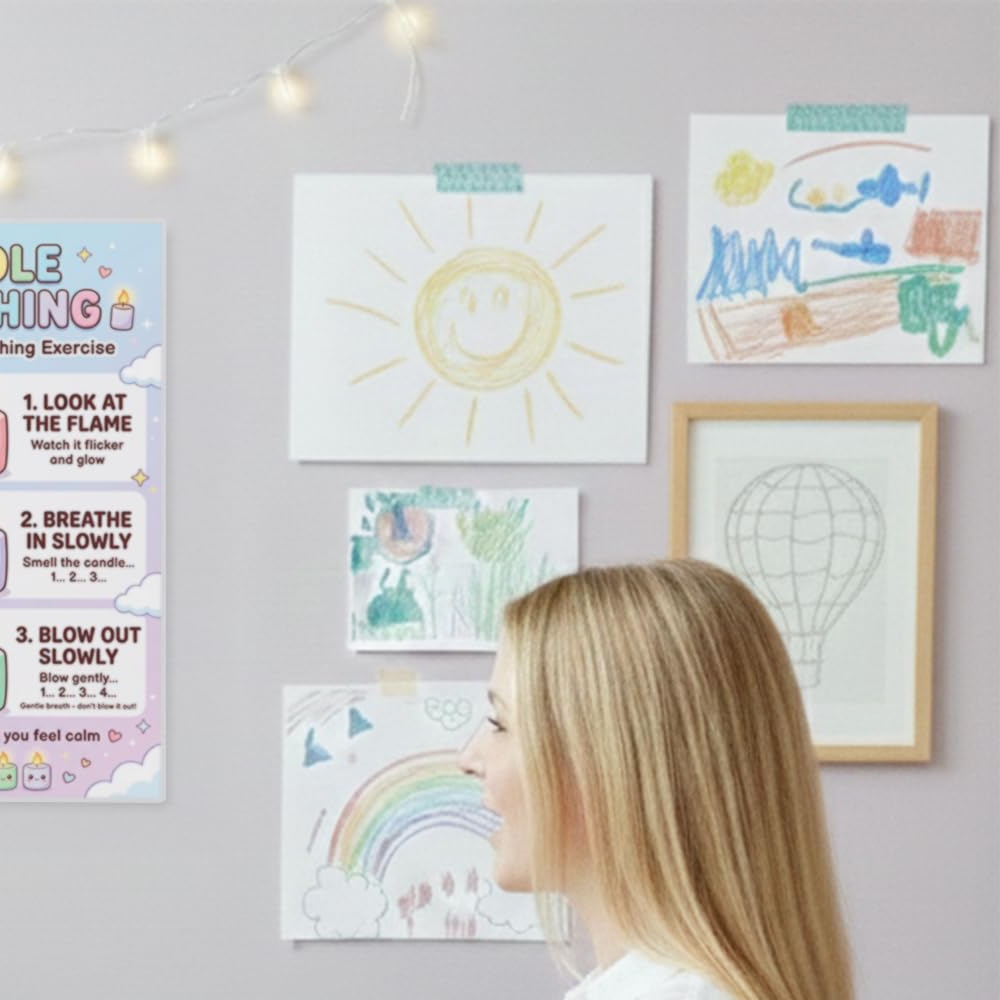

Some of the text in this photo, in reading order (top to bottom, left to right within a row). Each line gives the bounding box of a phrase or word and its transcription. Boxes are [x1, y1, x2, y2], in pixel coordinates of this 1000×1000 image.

[42, 340, 115, 354] Exercise
[24, 394, 127, 410] 1. LOOK AT
[23, 415, 132, 432] THE FLAME
[31, 440, 123, 450] Watch it flicker
[50, 454, 104, 467] and glow
[21, 511, 132, 528] 2. BREATHE
[27, 533, 131, 549] IN SLOWLY
[23, 556, 135, 568] Smell the candle...
[16, 626, 142, 643] 3. BLOW OUT
[39, 648, 118, 664] SLOWLY
[40, 672, 118, 685] Blow gently...
[20, 702, 44, 710] Gentle
[46, 702, 70, 710] breath
[77, 702, 95, 710] don't
[97, 702, 114, 710] blow
[116, 702, 121, 710] it
[122, 702, 137, 710] out!
[4, 732, 29, 744] you
[34, 729, 60, 741] feel
[65, 729, 100, 741] calm
